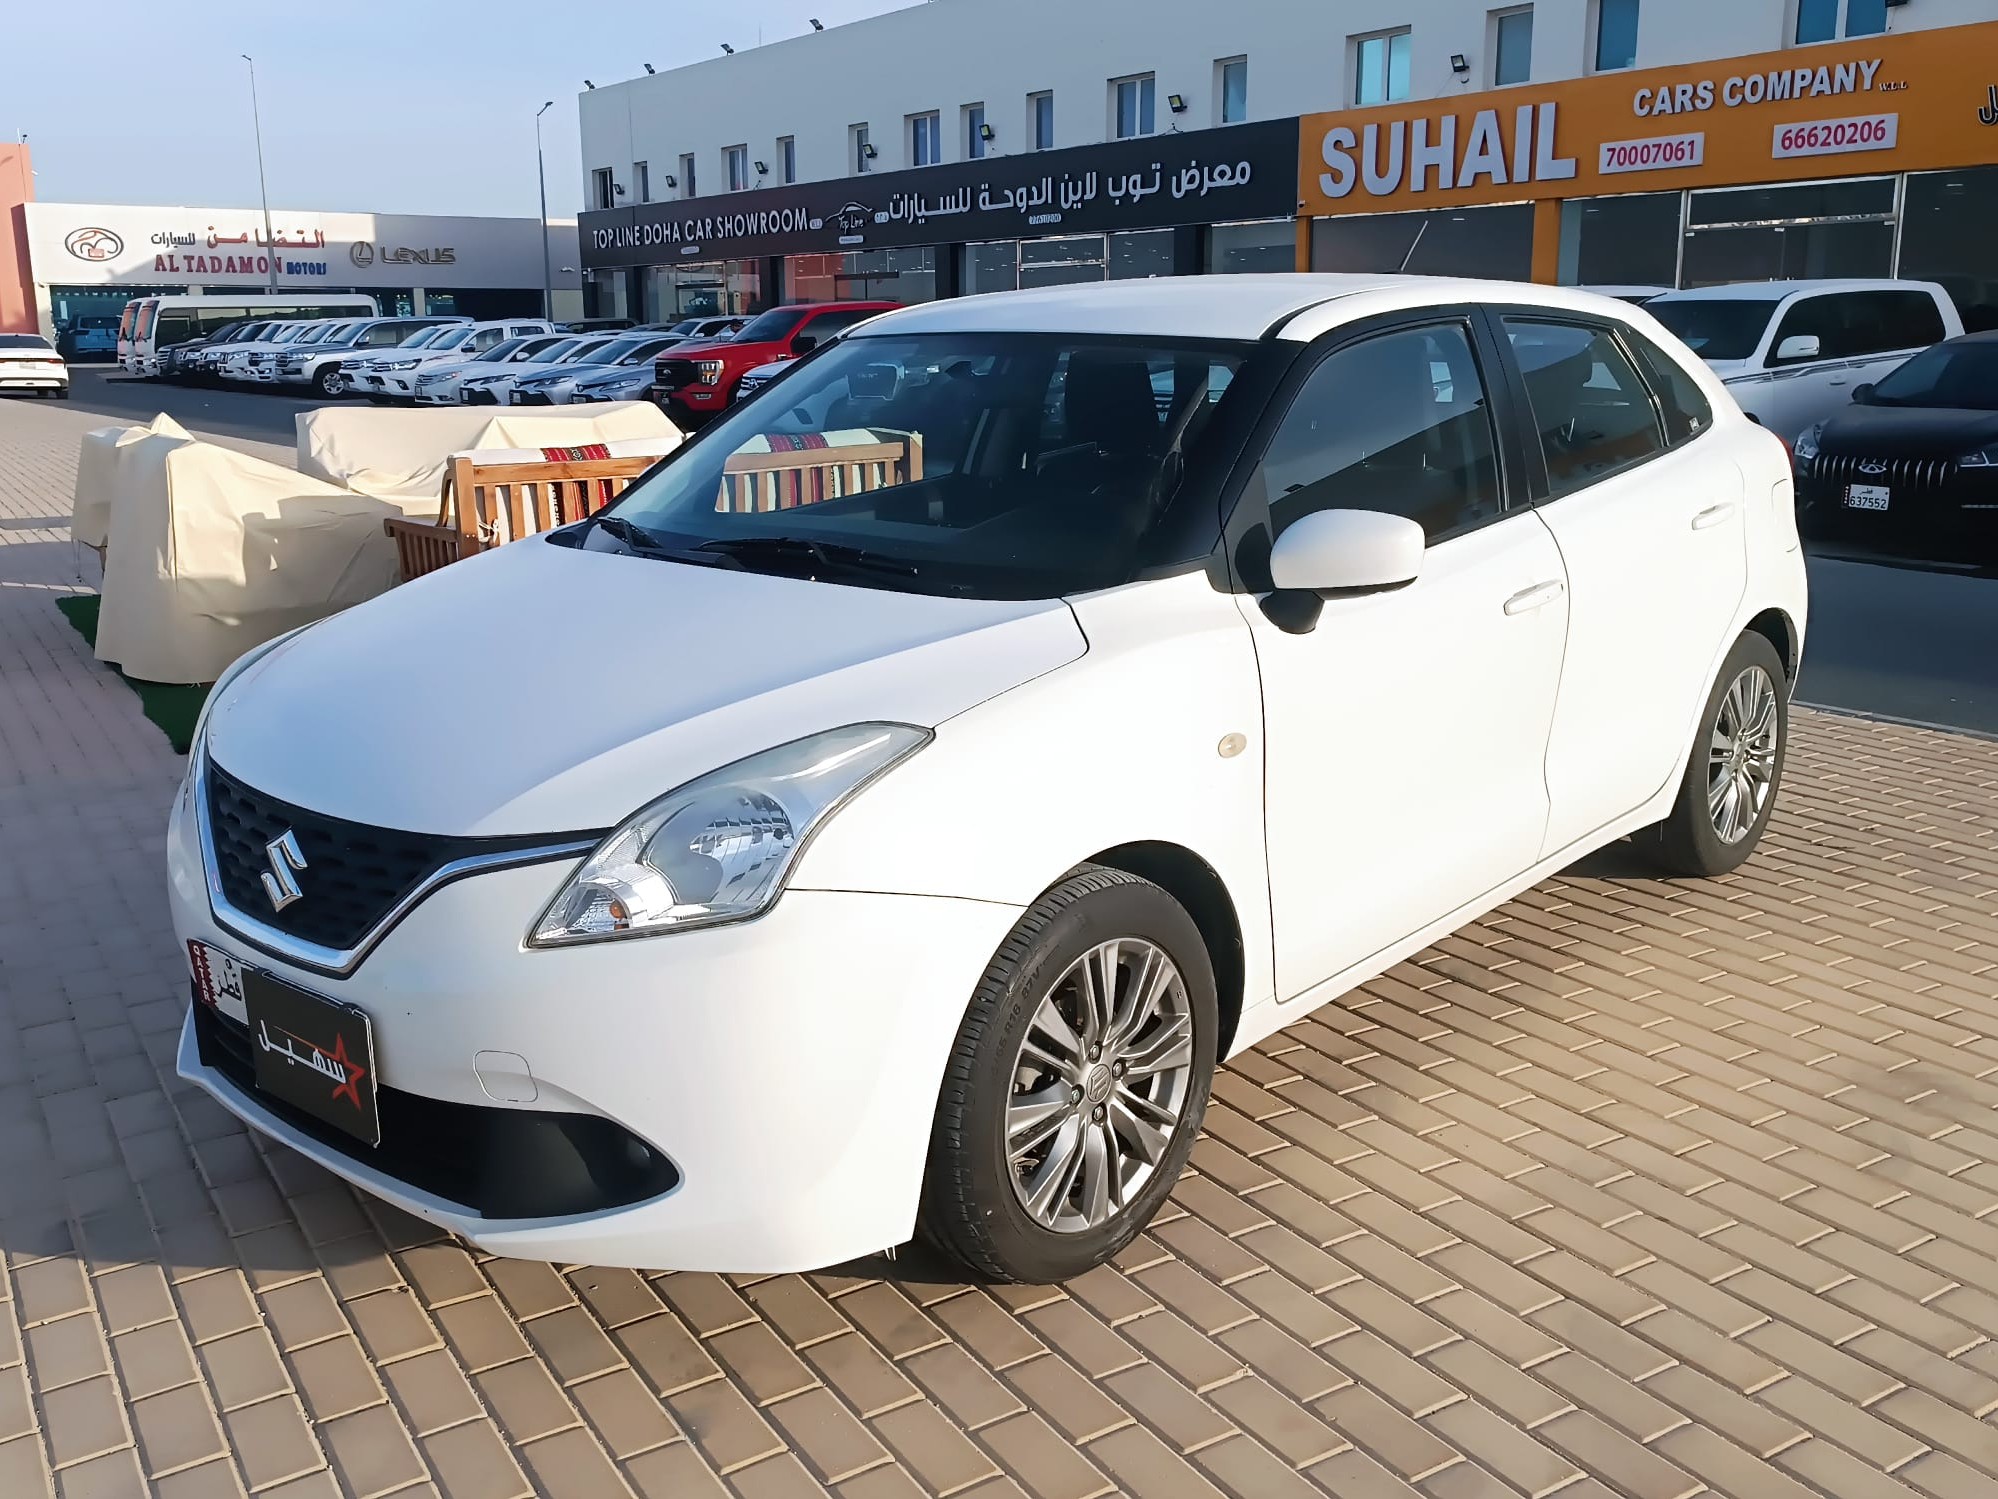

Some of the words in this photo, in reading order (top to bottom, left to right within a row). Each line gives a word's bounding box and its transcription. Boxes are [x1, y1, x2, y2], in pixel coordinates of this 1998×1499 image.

[1633, 80, 1715, 117] CARS
[1722, 58, 1883, 107] COMPANY
[1318, 102, 1577, 198] SUHAIL
[1606, 139, 1696, 168] 70007061
[1781, 118, 1887, 151] 66620206
[978, 176, 1052, 213] الدوحة
[1060, 171, 1097, 209] لاين
[1107, 162, 1161, 206] توب
[1171, 160, 1251, 199] معرض
[889, 186, 971, 225] للسيارات
[593, 228, 614, 249] TOP
[616, 225, 641, 247] LINE
[644, 221, 681, 245] DOHA
[684, 217, 713, 241] CAR
[716, 206, 808, 239] SHOWROOM
[154, 254, 180, 273] AL
[183, 255, 283, 275] TADAMON
[380, 246, 457, 265] LEXUS
[1850, 496, 1887, 509] 637552
[193, 945, 211, 1002] QATAR
[258, 1020, 346, 1084] سهيل
